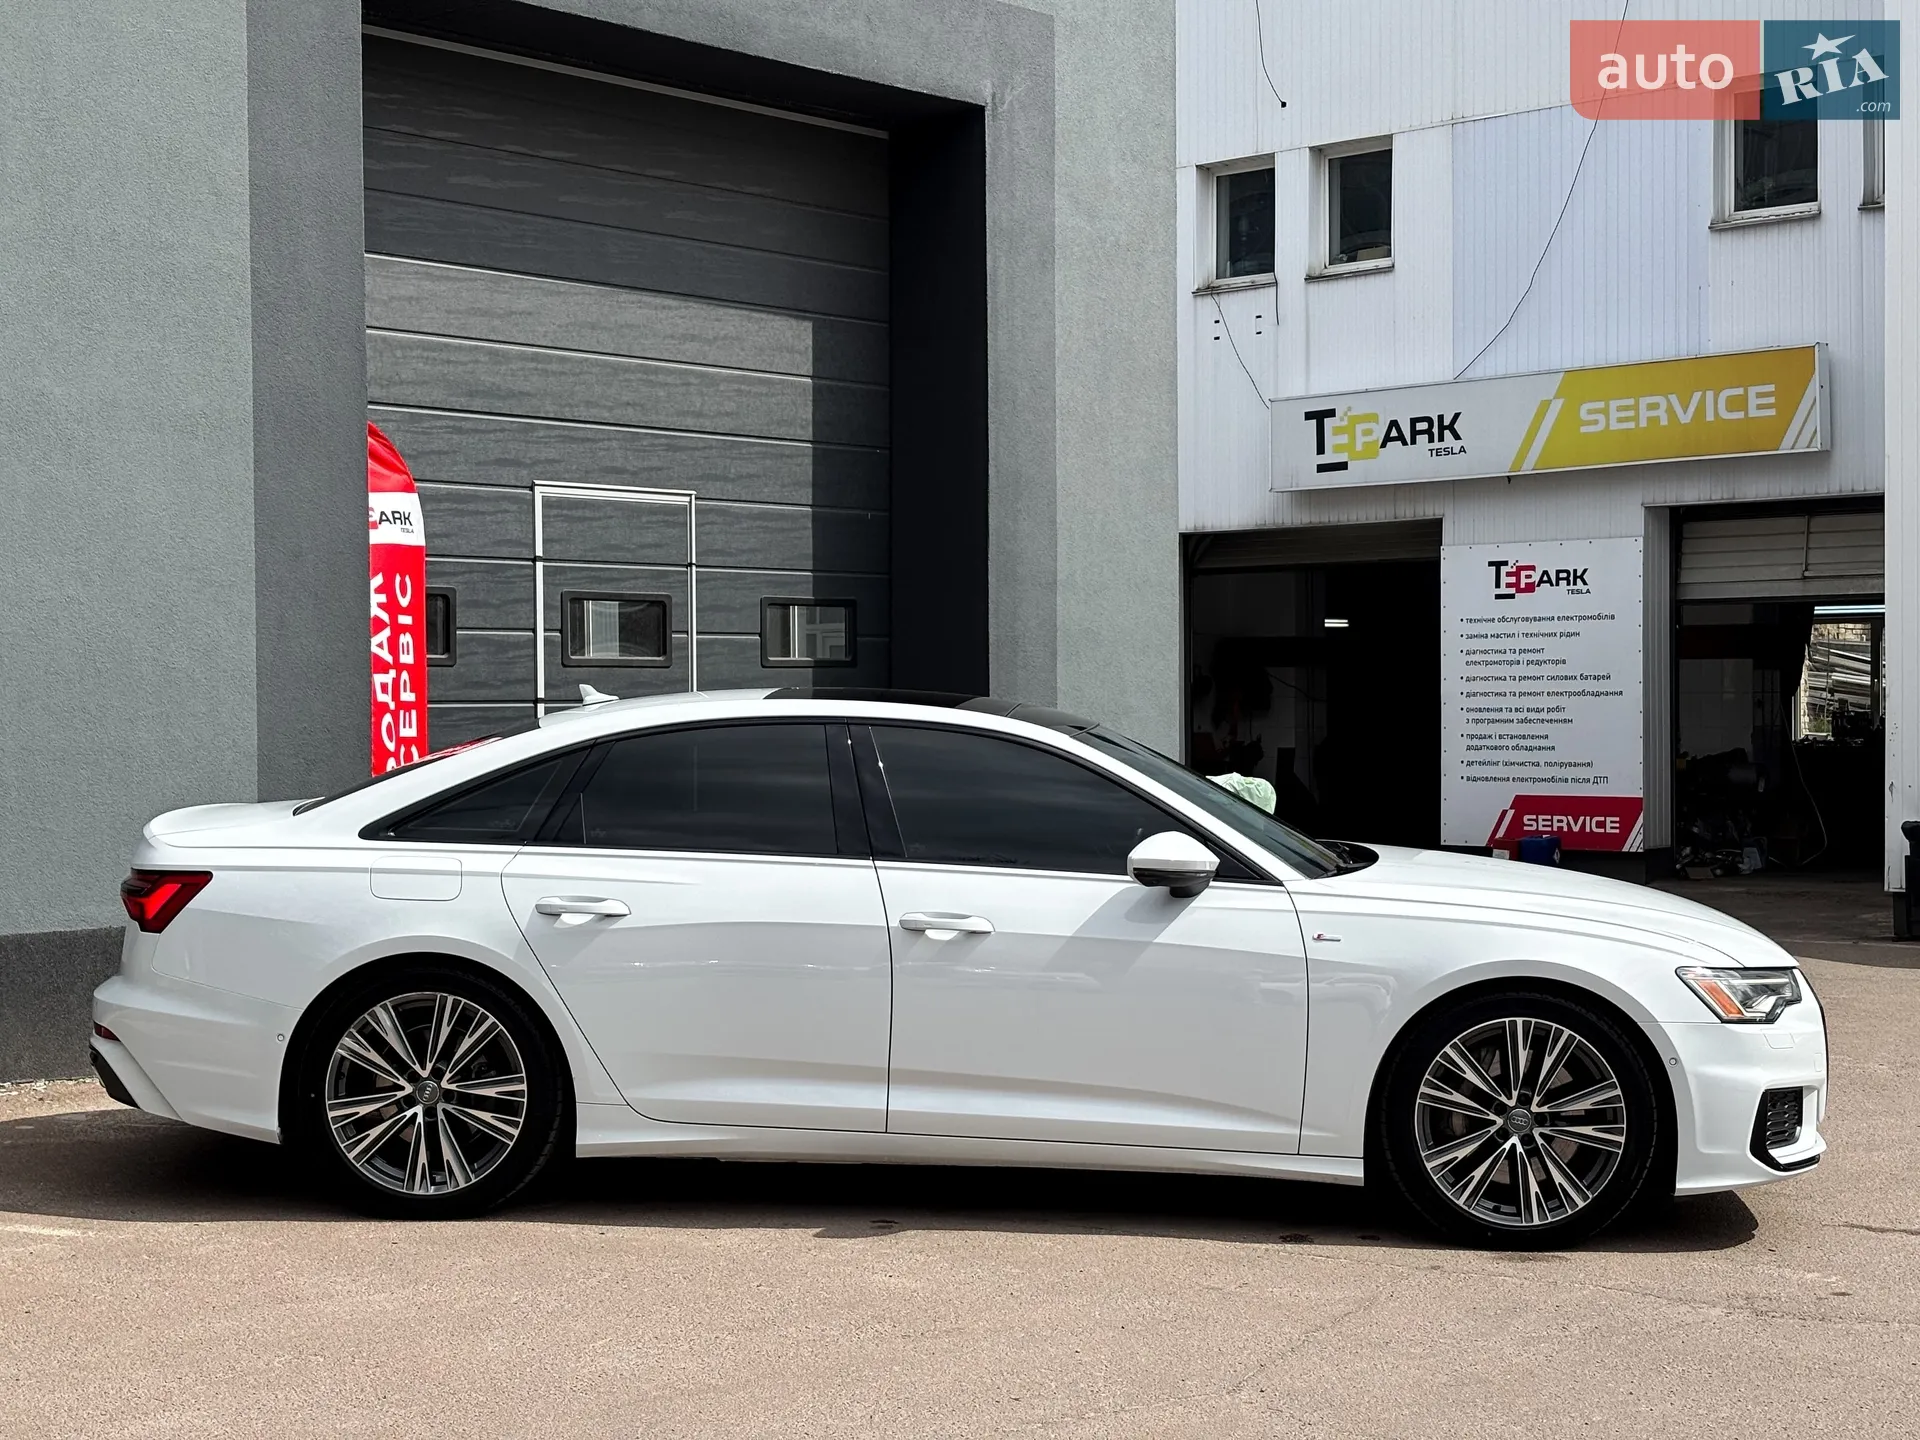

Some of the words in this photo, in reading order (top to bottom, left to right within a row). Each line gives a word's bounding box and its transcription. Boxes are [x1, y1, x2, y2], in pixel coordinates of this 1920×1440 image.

[1579, 384, 1776, 433] SERVICE
[1428, 445, 1467, 458] TESLA
[1465, 616, 1496, 624] технічне
[1497, 614, 1555, 626] обслуговування
[1556, 612, 1616, 623] електромобілів
[1465, 632, 1488, 640] заміна
[1490, 631, 1515, 639] мастил
[1521, 630, 1558, 638] технічних
[1559, 630, 1581, 639] рідин
[1465, 647, 1507, 656] діагностика
[1508, 647, 1517, 655] та
[1518, 646, 1545, 656] ремонт
[1465, 658, 1520, 668] електромоторів
[1526, 658, 1567, 667] редукторів
[1465, 673, 1507, 683] діагностика
[1508, 674, 1517, 682] та
[1518, 674, 1545, 683] ремонт
[1546, 674, 1578, 682] силових
[1579, 672, 1611, 682] батарей
[1465, 689, 1507, 699] діагностика
[1518, 690, 1545, 699] ремонт
[1546, 689, 1623, 698] електрообладнання
[1465, 706, 1503, 714] оновлення
[1505, 706, 1513, 714] та
[1514, 705, 1525, 714] всі
[1526, 706, 1545, 714] види
[1546, 705, 1566, 715] робіт
[1471, 717, 1514, 726] програмним
[1466, 733, 1493, 742] продаж
[1498, 733, 1549, 741] встановлення
[1465, 744, 1510, 752] додаткового
[1511, 743, 1556, 752] обладнання
[1465, 759, 1500, 768] детейлінг
[1543, 760, 1593, 769] полірування)
[1466, 774, 1510, 783] відновлення
[1512, 775, 1569, 785] електромобілів
[1570, 776, 1591, 784] після
[1592, 776, 1609, 785] ДТП
[1523, 815, 1620, 833] SERVICE
